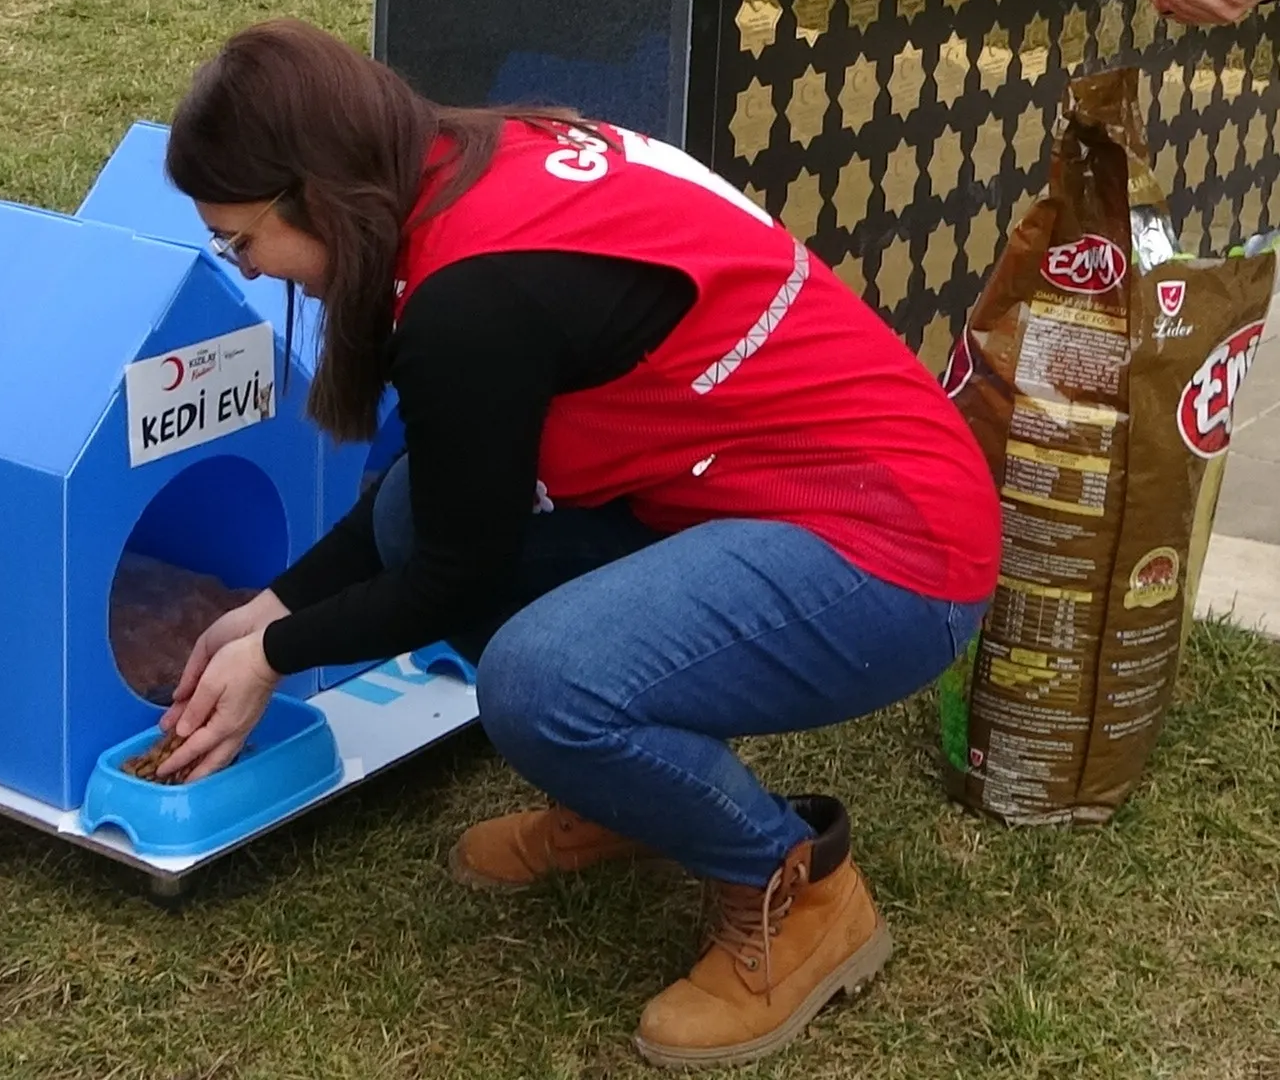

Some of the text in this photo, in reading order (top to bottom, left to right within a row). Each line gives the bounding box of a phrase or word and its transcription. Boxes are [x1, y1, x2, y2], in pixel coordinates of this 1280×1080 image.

[1048, 243, 1118, 286] Enjoy
[1152, 313, 1194, 339] Lider
[141, 369, 261, 450] KEDİ EVİ
